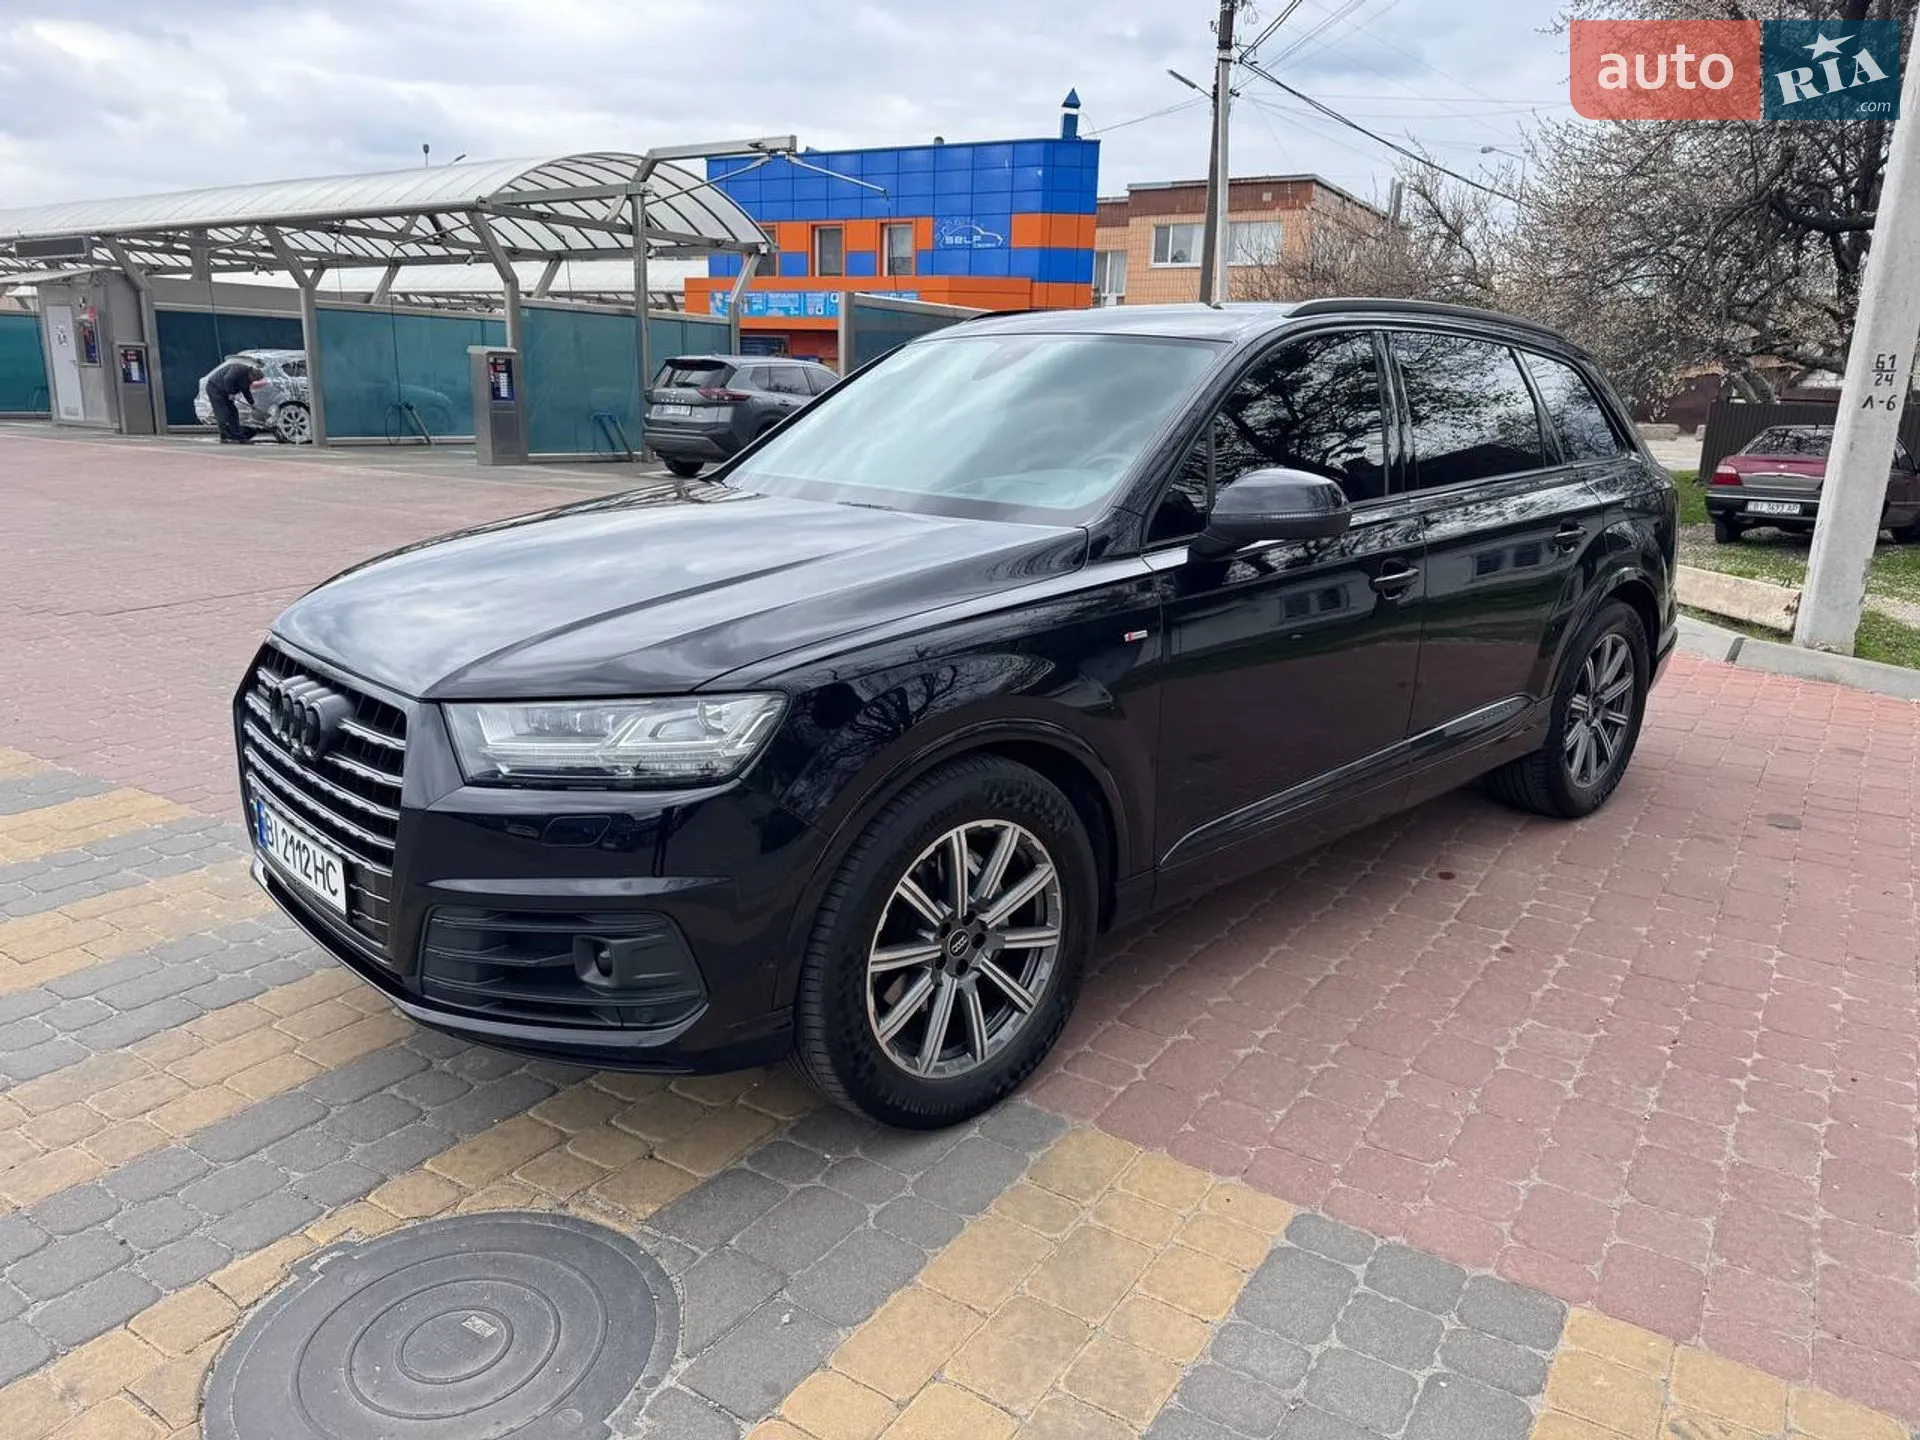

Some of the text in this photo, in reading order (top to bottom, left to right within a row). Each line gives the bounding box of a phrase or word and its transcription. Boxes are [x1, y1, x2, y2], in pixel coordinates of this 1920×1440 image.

[1874, 373, 1894, 387] 24
[263, 811, 339, 897] BI 2112 HC
